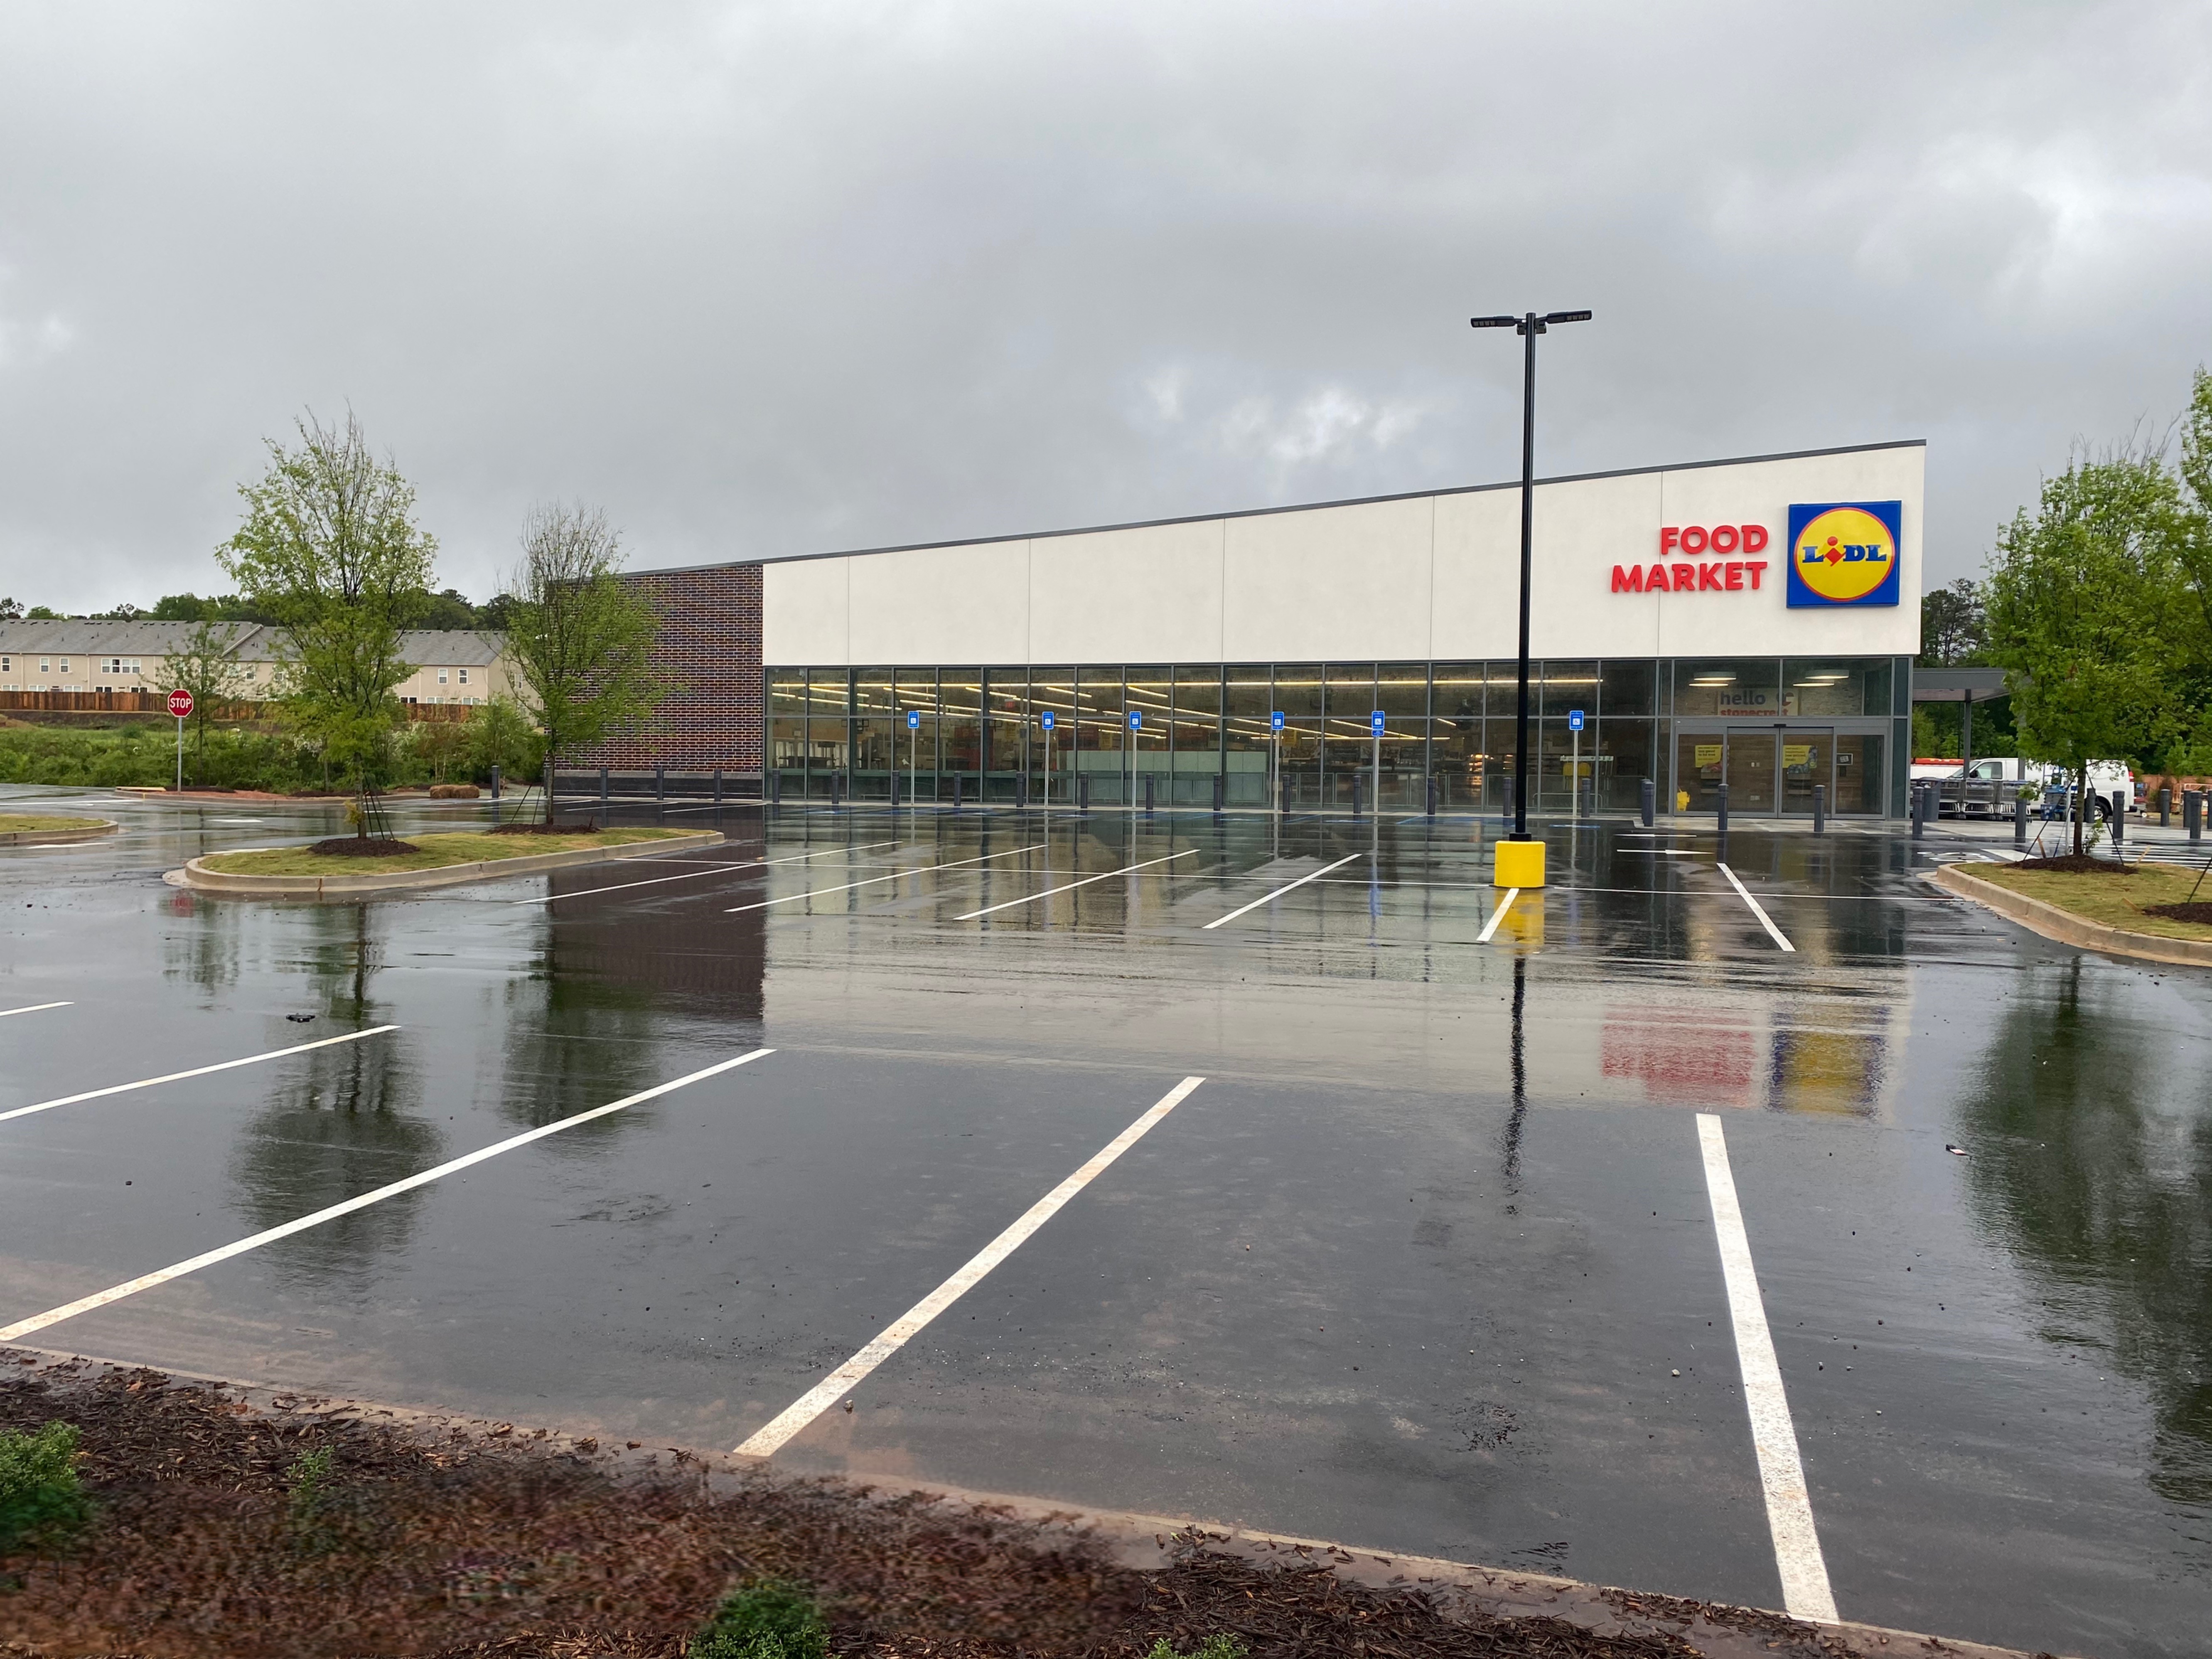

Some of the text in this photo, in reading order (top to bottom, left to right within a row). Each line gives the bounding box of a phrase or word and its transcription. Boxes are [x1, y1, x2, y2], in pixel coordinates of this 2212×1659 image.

[1661, 525, 1768, 554] FOOD
[1612, 561, 1767, 592] MARKET
[170, 697, 192, 708] STOP
[1720, 690, 1765, 705] hello
